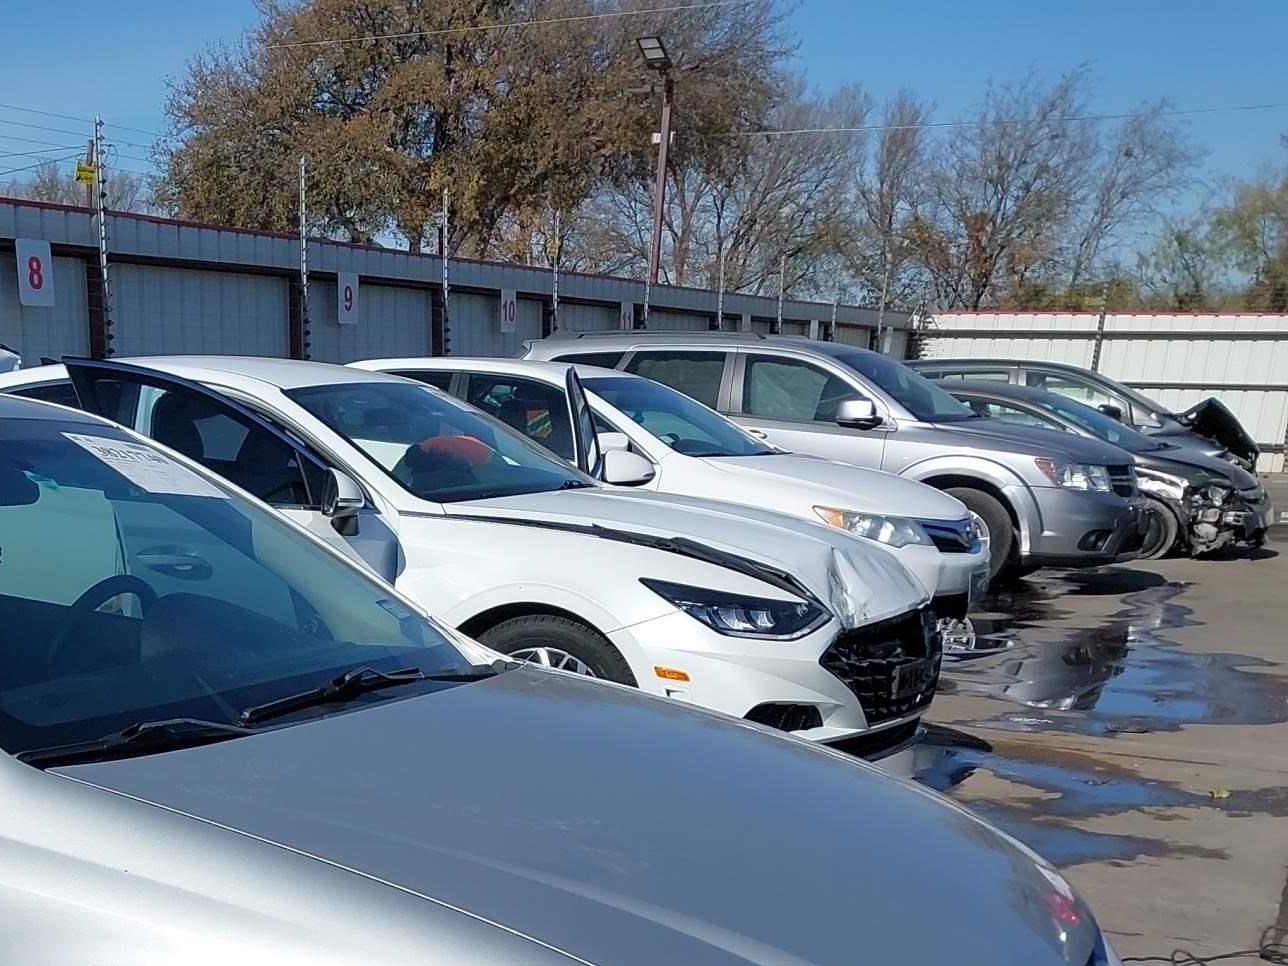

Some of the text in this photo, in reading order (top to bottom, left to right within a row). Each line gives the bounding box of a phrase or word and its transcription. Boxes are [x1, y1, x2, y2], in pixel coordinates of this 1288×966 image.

[28, 255, 43, 290] 8
[344, 286, 353, 311] 9
[503, 300, 515, 321] 10
